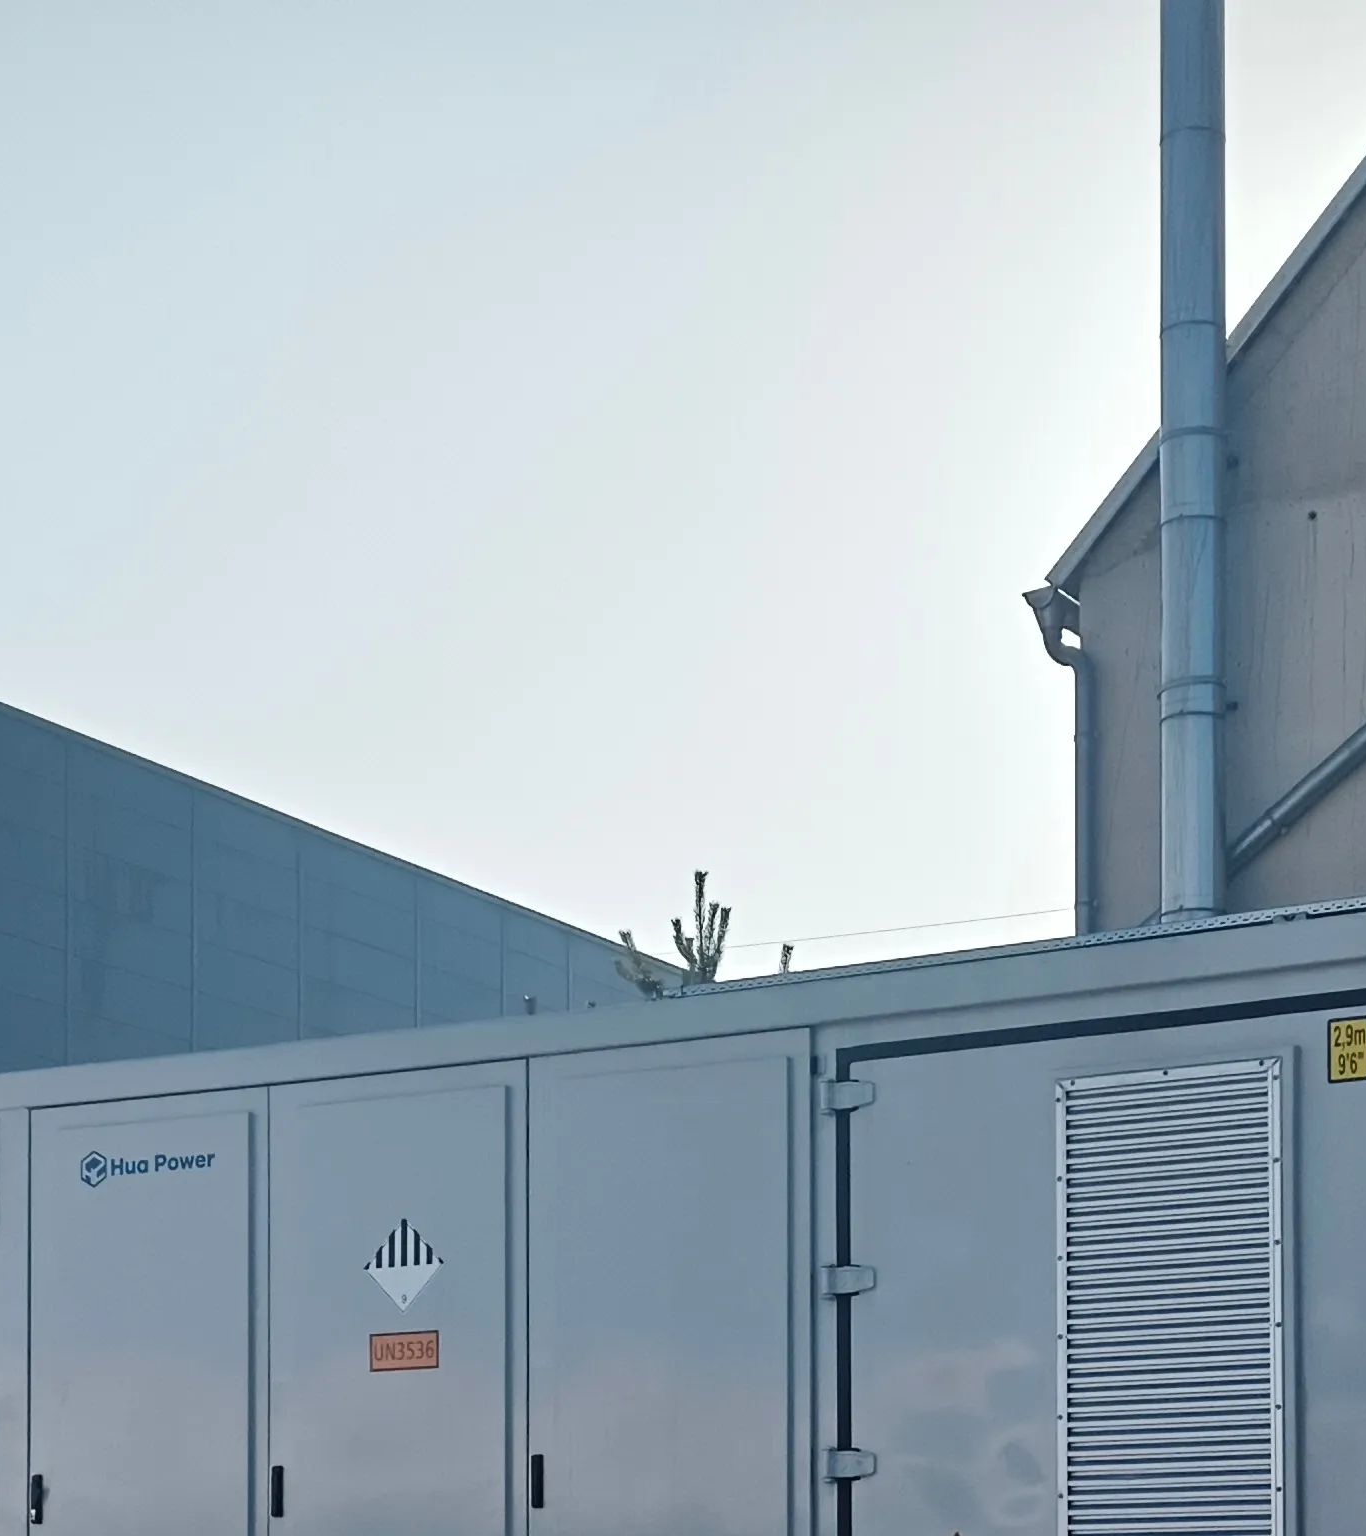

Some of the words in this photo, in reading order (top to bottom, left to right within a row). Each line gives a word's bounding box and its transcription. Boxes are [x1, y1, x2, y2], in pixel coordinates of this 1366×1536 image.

[1334, 1024, 1366, 1051] 2,9m
[111, 1157, 149, 1176] Hua
[154, 1153, 216, 1172] Power
[401, 1294, 408, 1304] 9
[373, 1339, 435, 1362] UN3536
